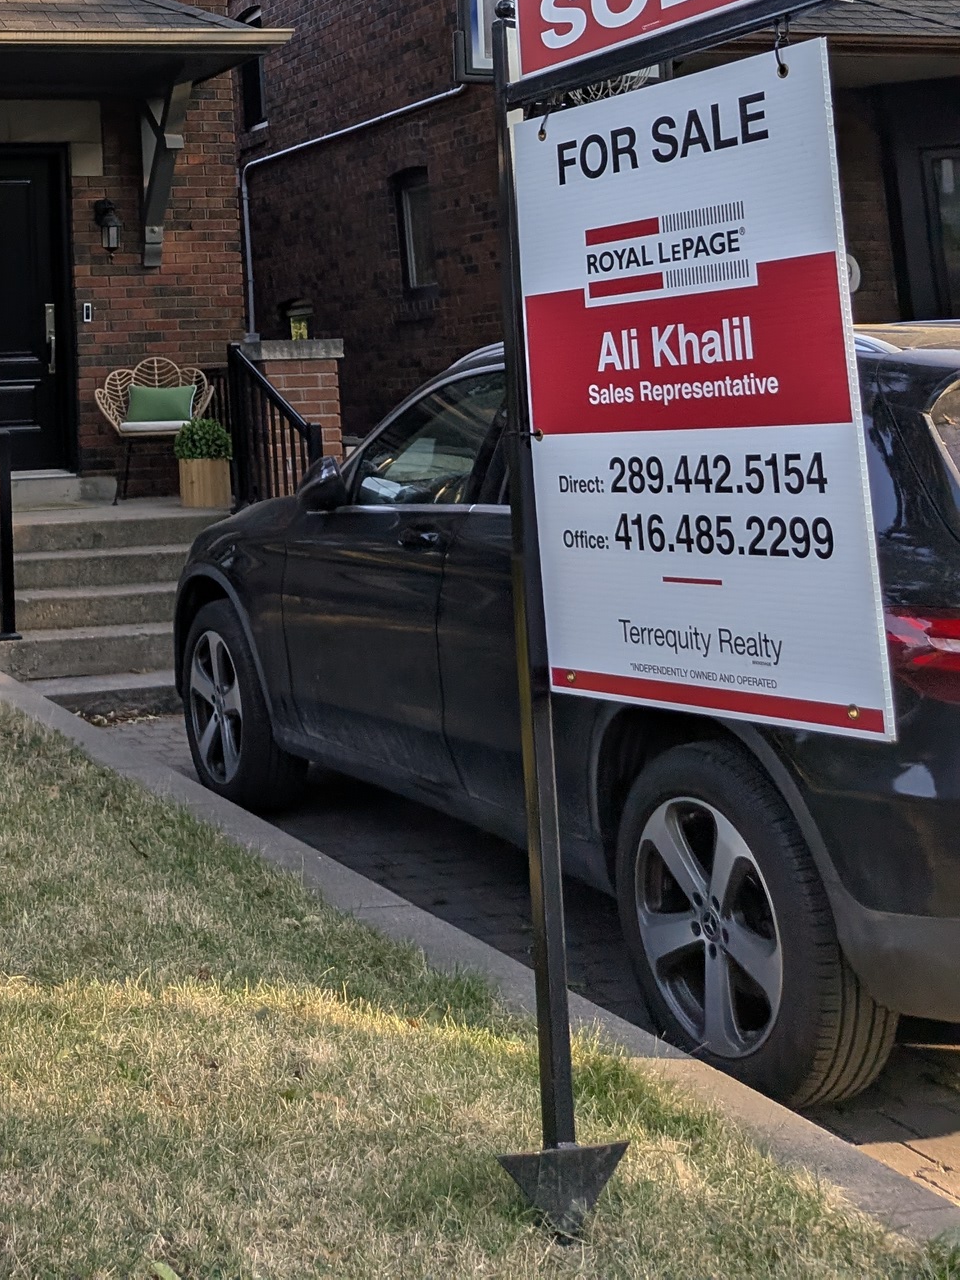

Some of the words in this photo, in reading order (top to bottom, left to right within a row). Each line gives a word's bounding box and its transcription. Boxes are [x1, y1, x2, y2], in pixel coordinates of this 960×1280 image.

[556, 126, 639, 186] FOR
[651, 91, 769, 164] SALE
[586, 244, 654, 275] ROYAL
[597, 328, 640, 372] Ali
[651, 315, 754, 368] Khalil
[588, 383, 635, 405] Sales
[639, 372, 780, 406] Representative
[558, 475, 605, 494] Direct:
[609, 451, 828, 495] 289.442.5154
[563, 529, 610, 550] Office:
[614, 513, 834, 560] 416.485.2299
[618, 618, 712, 658] Terrequity
[717, 627, 783, 666] Realty
[689, 669, 718, 682] OWNED
[719, 674, 736, 684] AND
[736, 675, 778, 690] OPERATED
